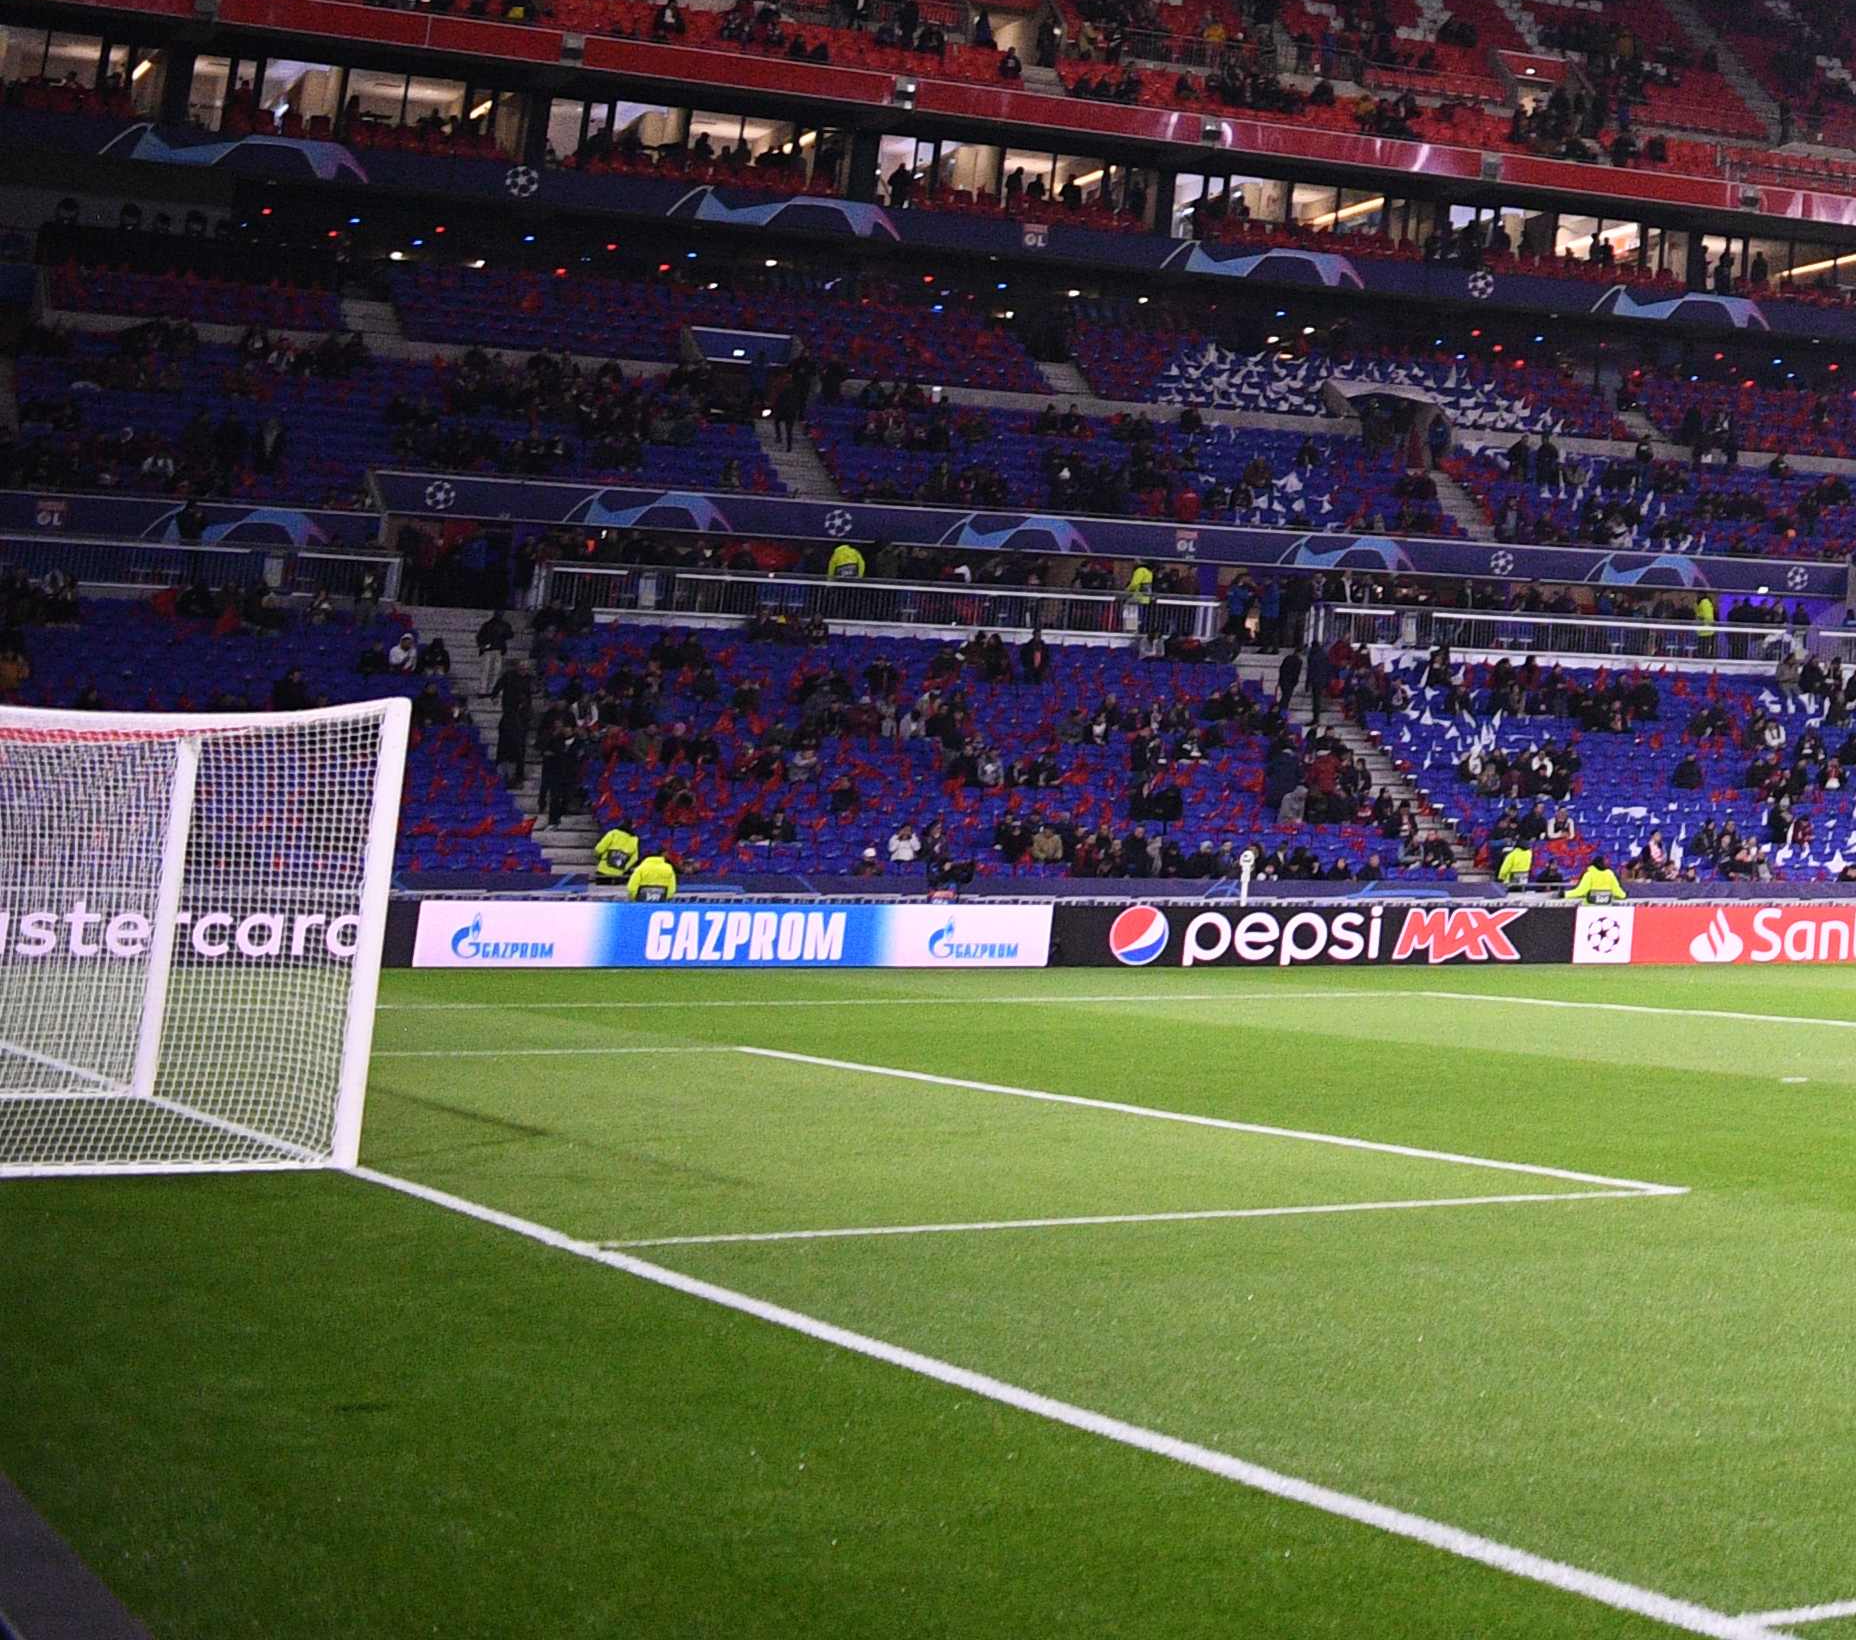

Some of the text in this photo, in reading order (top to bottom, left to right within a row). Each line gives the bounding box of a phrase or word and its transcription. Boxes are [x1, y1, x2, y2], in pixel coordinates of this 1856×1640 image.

[1024, 233, 1048, 248] OL
[1176, 540, 1196, 553] OL
[645, 911, 847, 961] GAZPROM
[1182, 906, 1528, 967] pepsi MAX
[481, 942, 555, 959] GAZPROM
[955, 943, 1019, 959] GAZPROM
